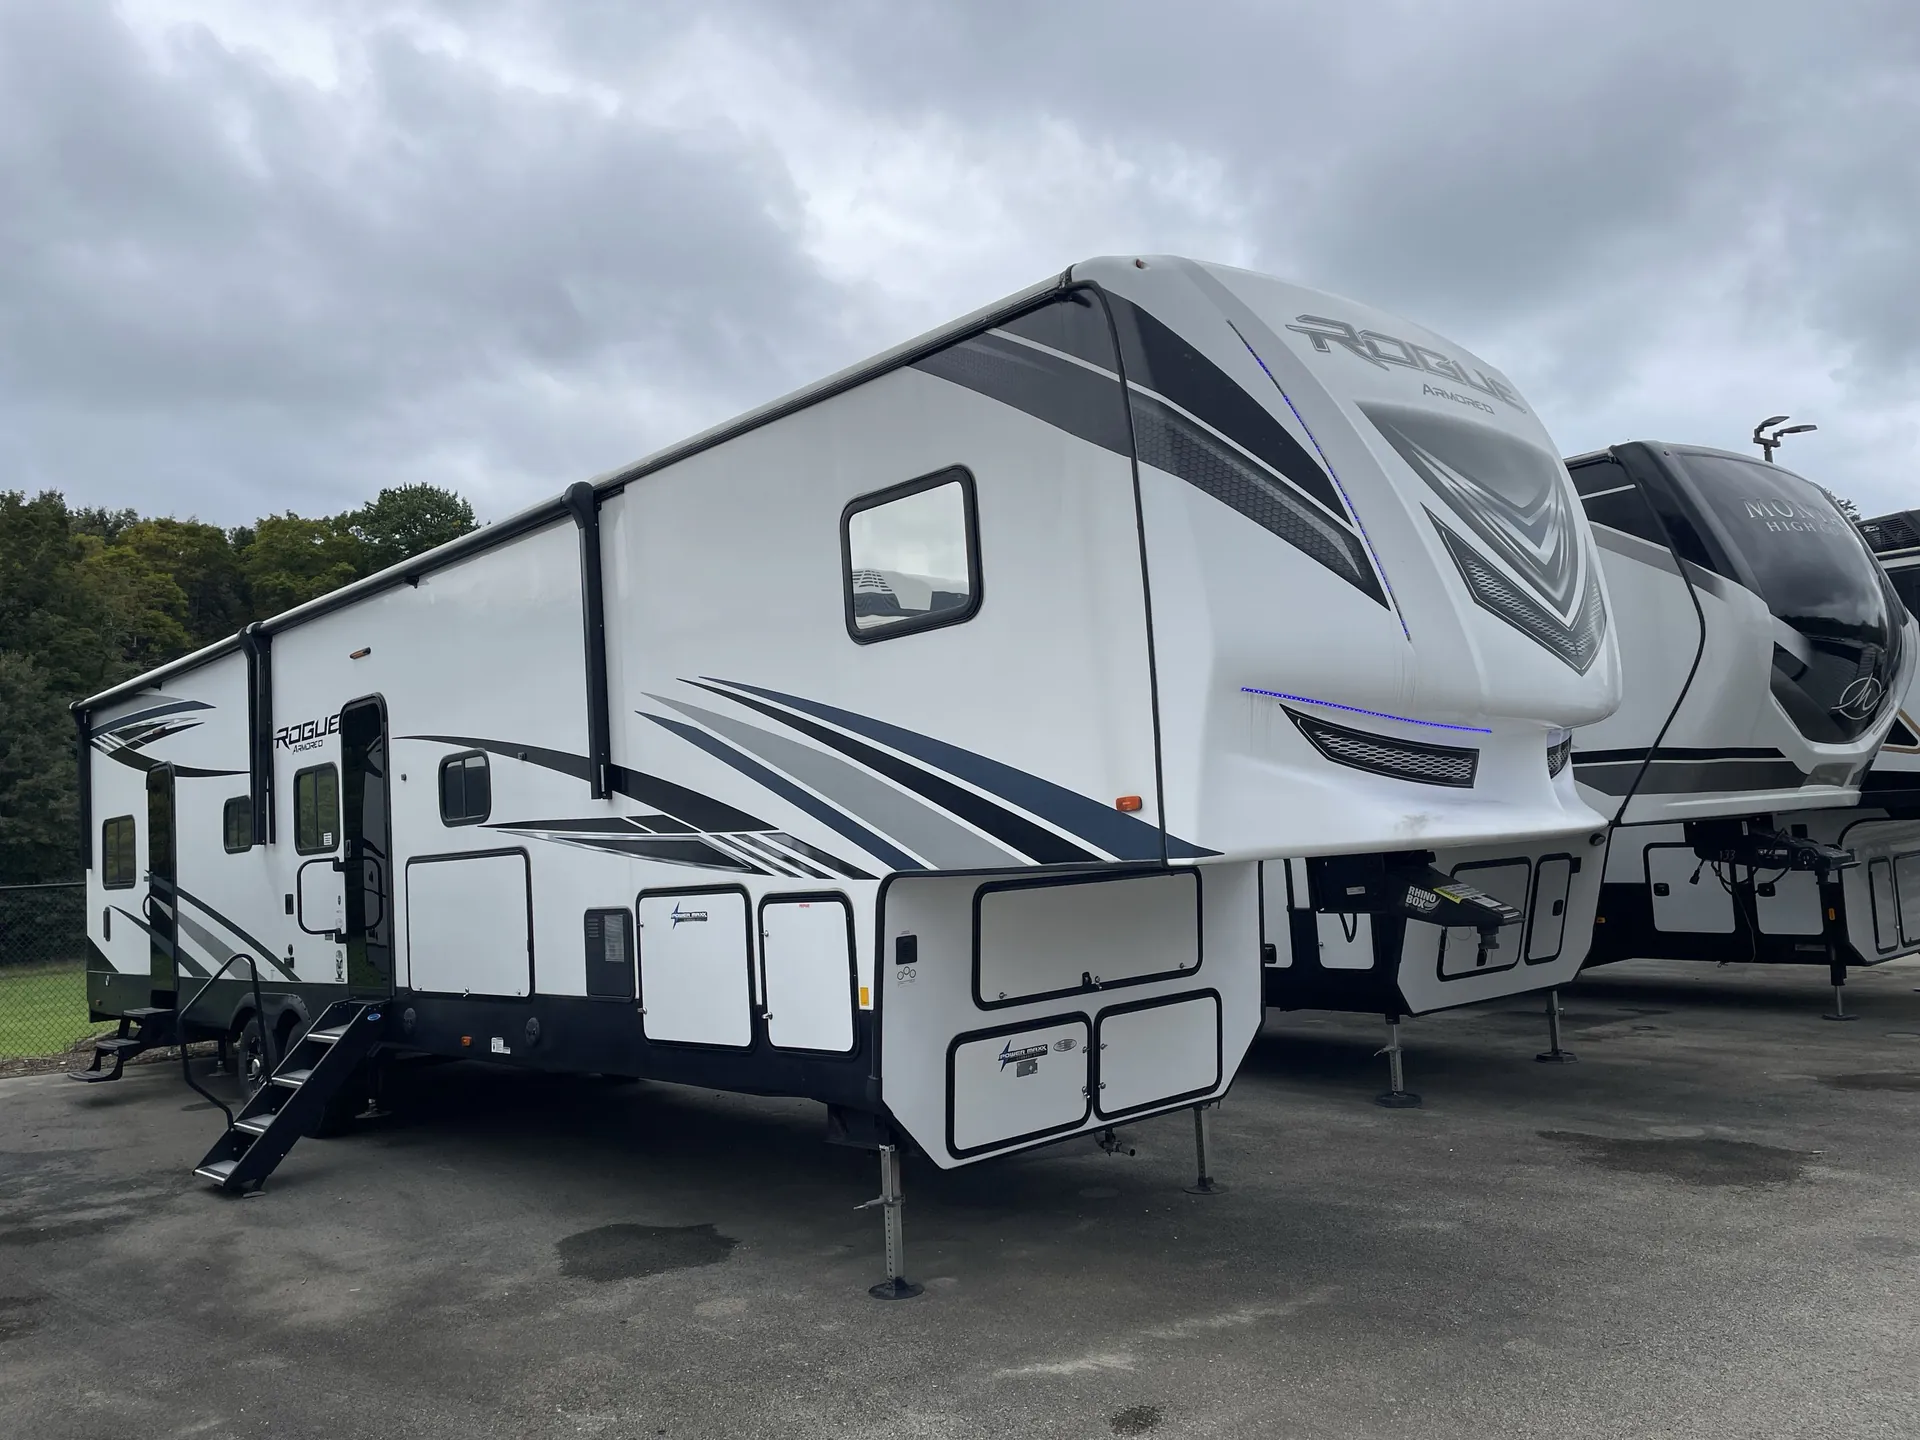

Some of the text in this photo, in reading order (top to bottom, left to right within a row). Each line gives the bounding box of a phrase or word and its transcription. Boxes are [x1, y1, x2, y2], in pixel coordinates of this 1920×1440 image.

[1285, 314, 1527, 414] ROGUE
[1422, 382, 1496, 415] ARMORED
[1765, 520, 1818, 533] HIGH
[273, 713, 341, 750] ROGUE
[1405, 894, 1426, 909] BOX
[1408, 885, 1436, 903] RHINO
[1000, 1048, 1025, 1060] POWER
